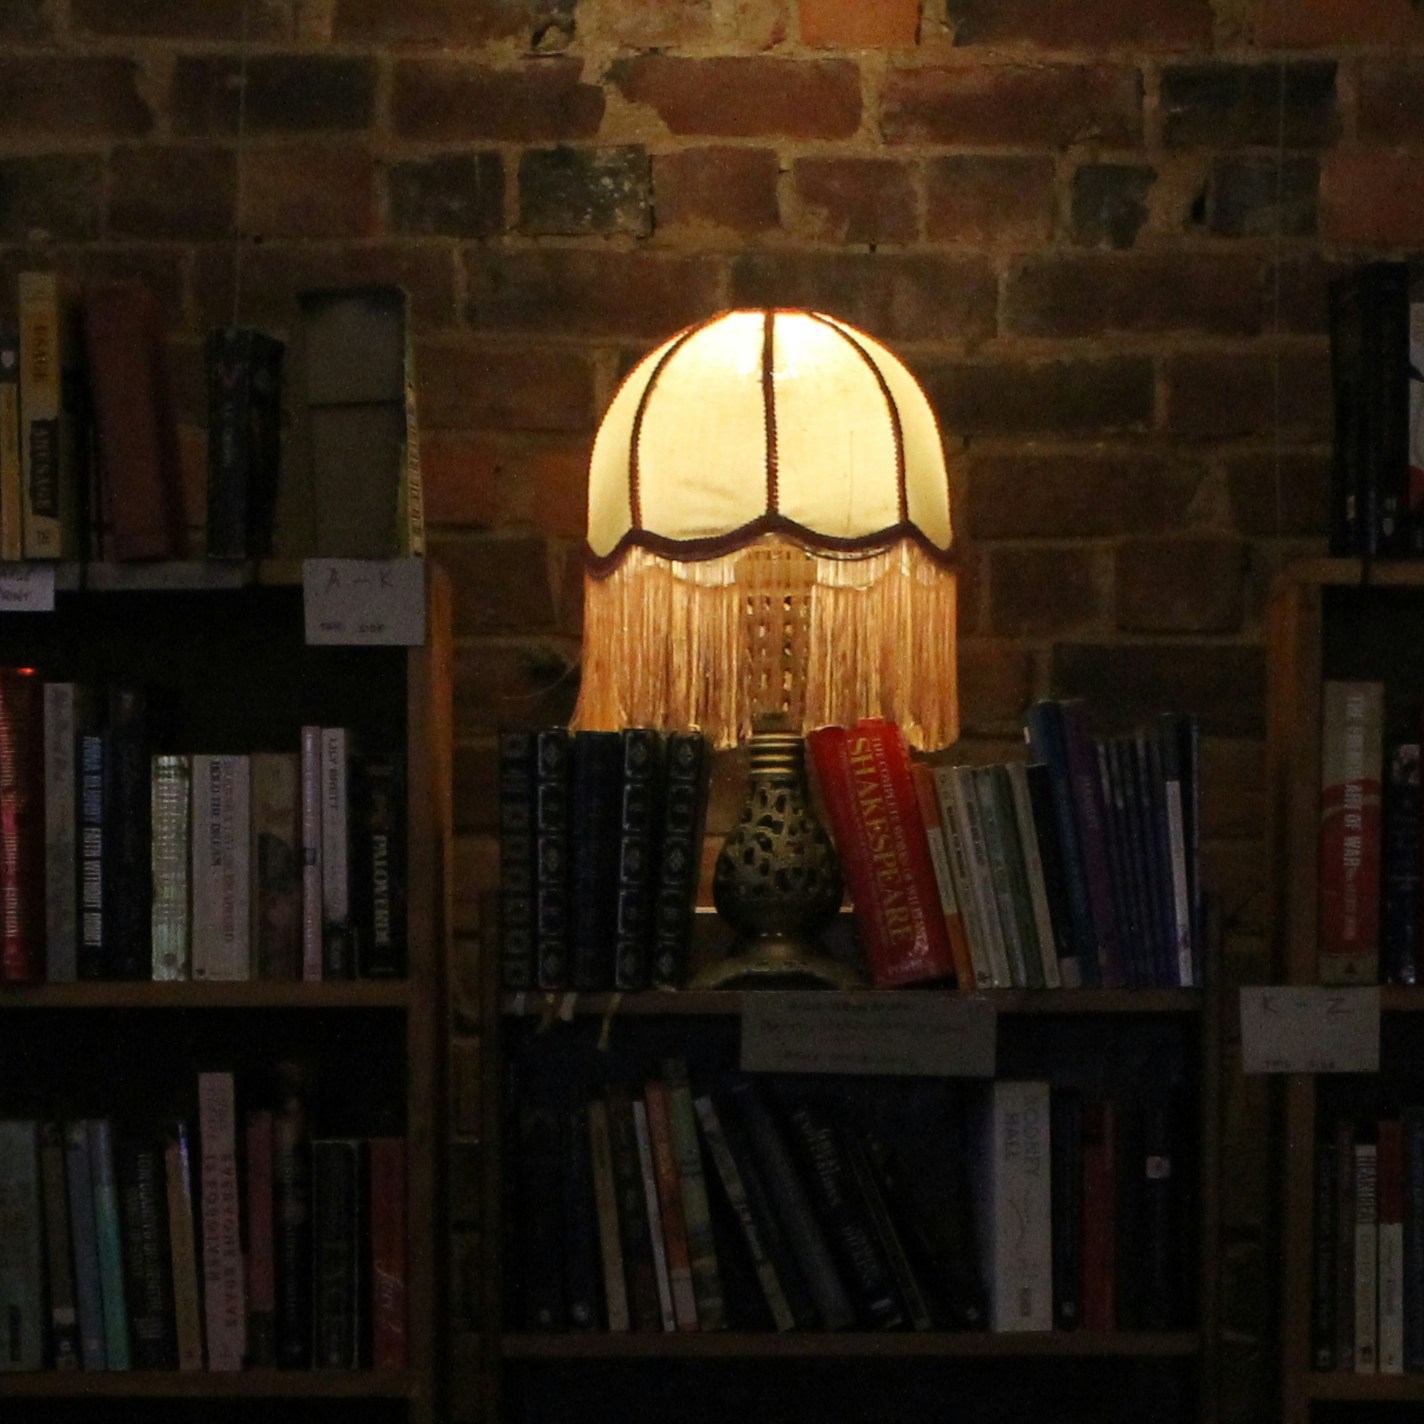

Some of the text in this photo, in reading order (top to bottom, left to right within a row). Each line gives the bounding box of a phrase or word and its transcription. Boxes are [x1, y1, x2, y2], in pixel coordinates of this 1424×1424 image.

[32, 325, 49, 383] USAGE
[324, 567, 394, 594] A K
[1344, 783, 1363, 811] ART
[848, 737, 916, 948] SHAKESPEARE
[1344, 823, 1363, 838] OF
[1343, 845, 1362, 878] WAR
[372, 834, 392, 950] PALOVERDE
[1003, 1111, 1023, 1161] HALL
